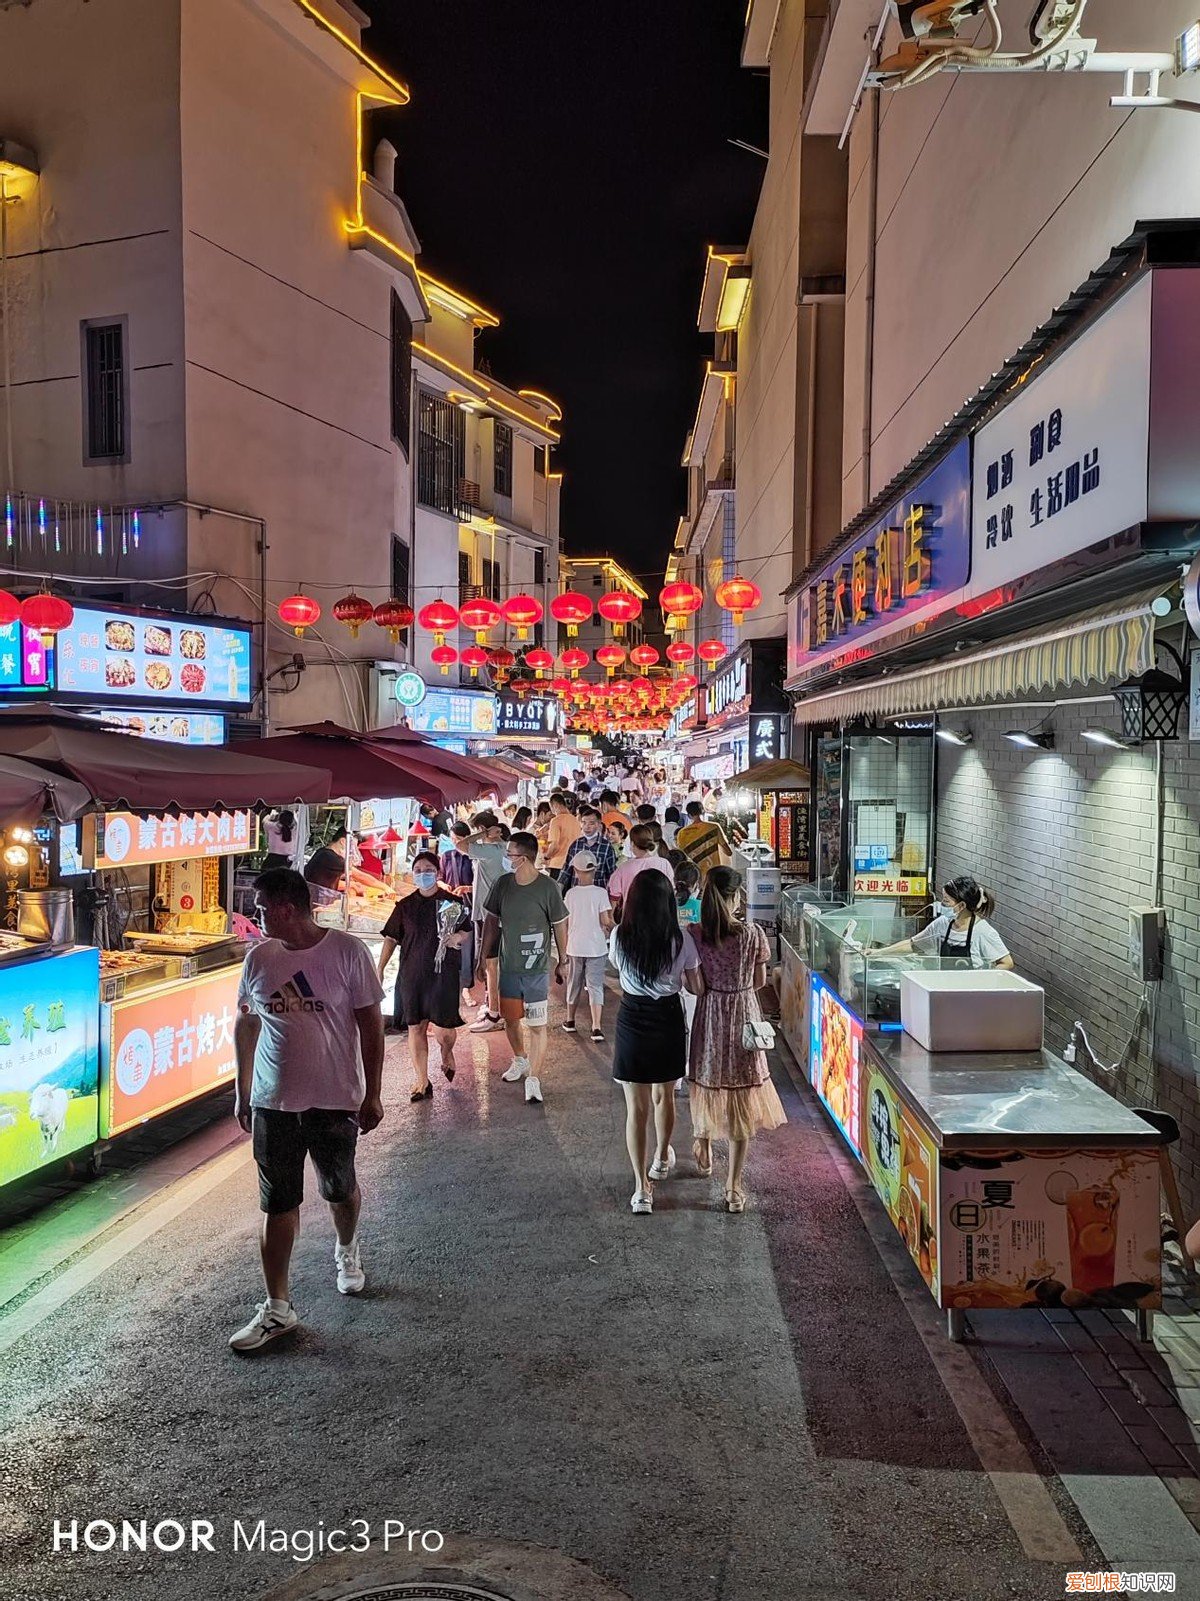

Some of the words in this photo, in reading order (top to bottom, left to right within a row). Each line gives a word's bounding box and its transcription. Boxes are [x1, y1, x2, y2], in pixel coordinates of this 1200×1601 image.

[1029, 447, 1100, 528] 生活用品
[138, 812, 247, 850] 蒙古烤大肉串
[263, 997, 325, 1014] adidas
[980, 1180, 1016, 1210] 夏
[976, 1233, 991, 1274] 水果茶
